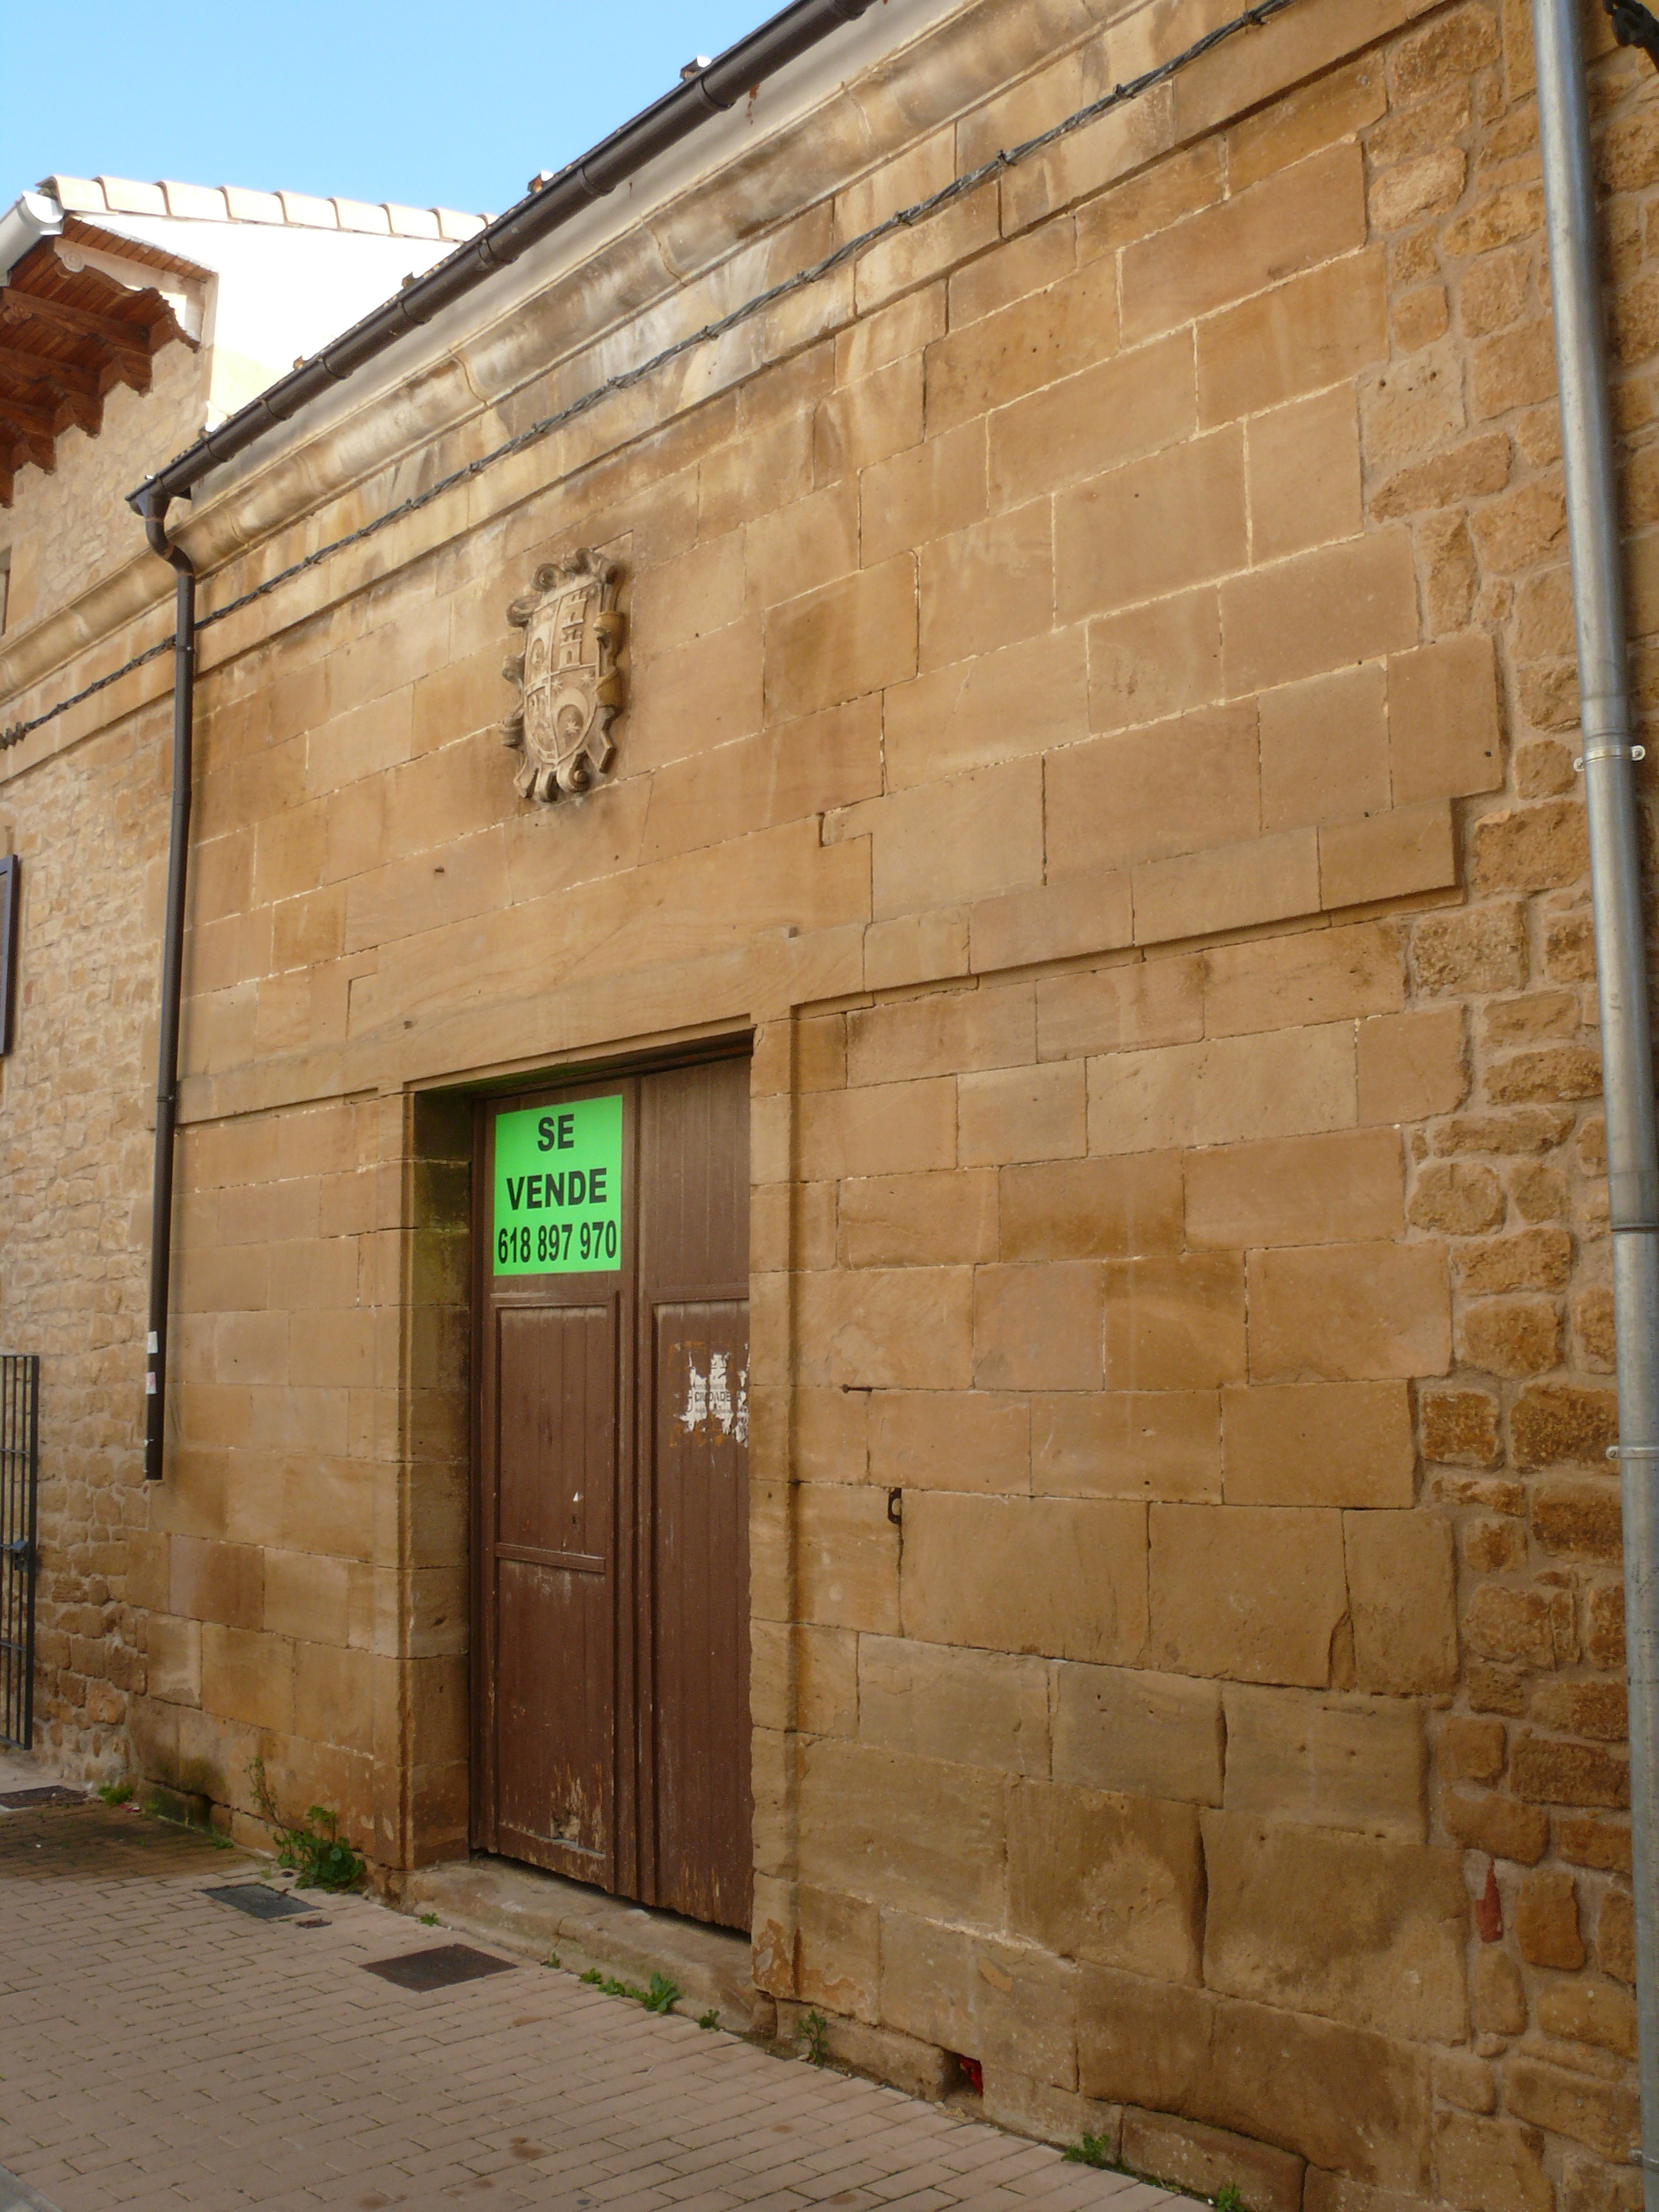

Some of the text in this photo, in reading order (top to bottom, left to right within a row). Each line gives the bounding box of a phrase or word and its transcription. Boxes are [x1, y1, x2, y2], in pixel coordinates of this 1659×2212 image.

[537, 1113, 575, 1151] SE
[506, 1167, 608, 1210] VENDE
[498, 1220, 617, 1264] 618 897 970
